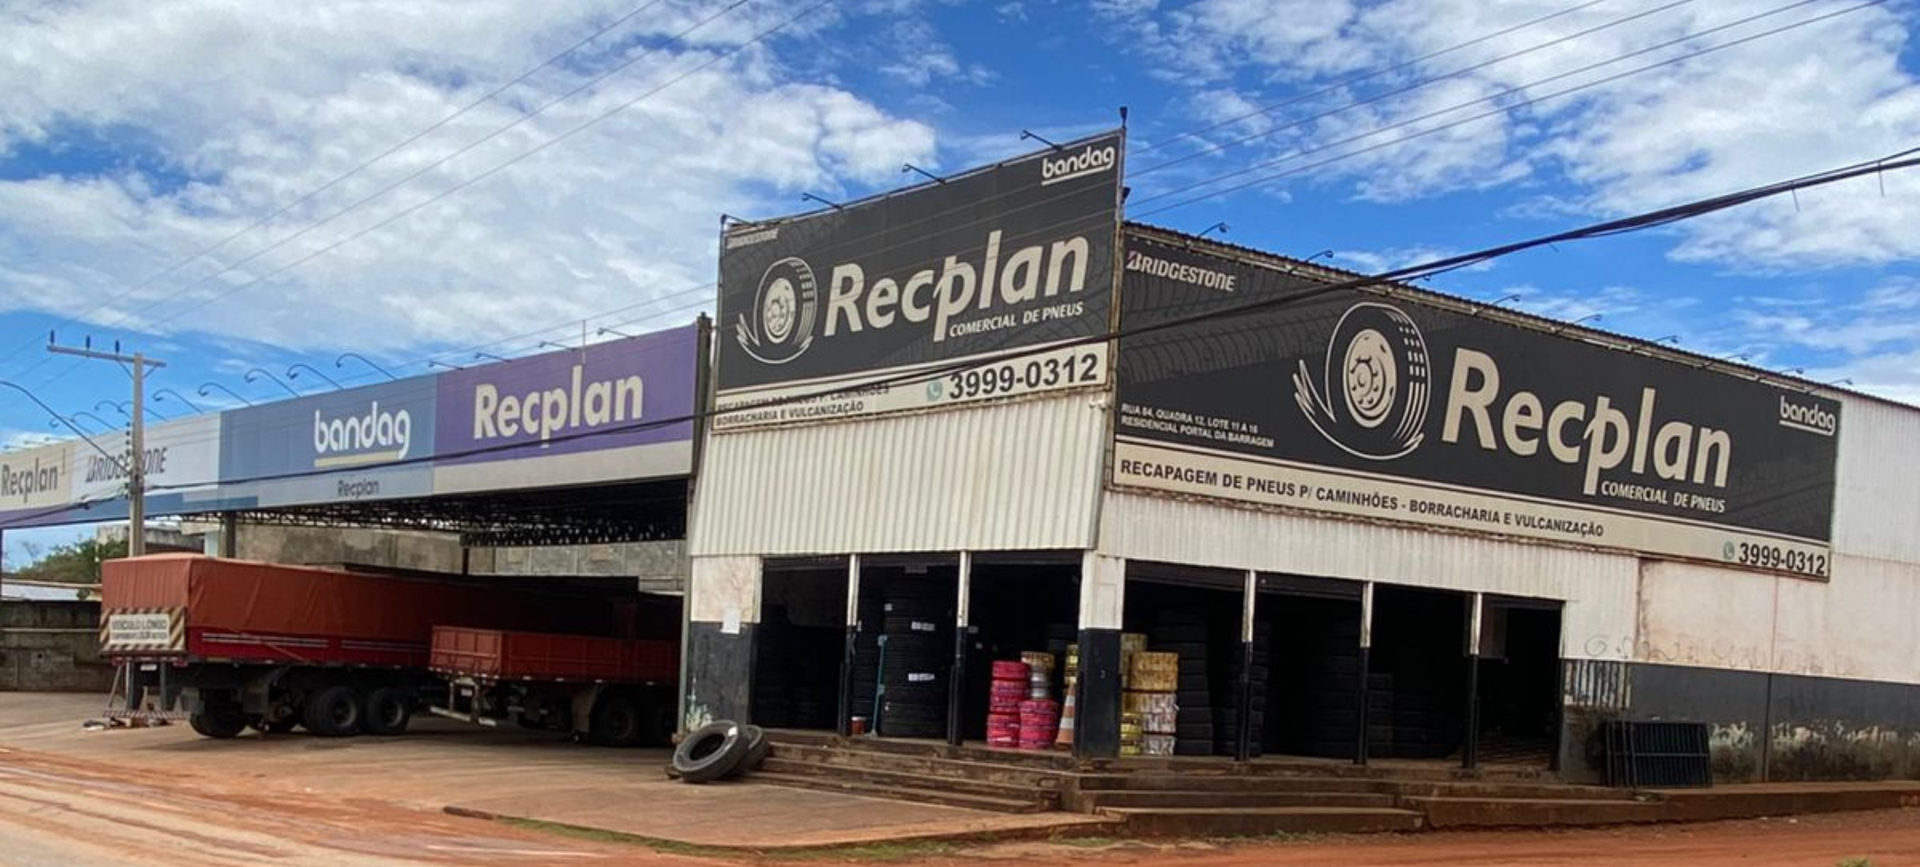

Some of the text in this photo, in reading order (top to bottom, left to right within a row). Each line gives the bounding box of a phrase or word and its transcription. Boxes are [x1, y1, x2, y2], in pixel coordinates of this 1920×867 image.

[1042, 146, 1115, 178] bandag
[823, 229, 1090, 343] Recplan
[1126, 250, 1237, 292] BRIDGESTONE
[949, 301, 1084, 338] COMERCIAL DE PNEUS
[948, 353, 1099, 399] 3999-0312
[473, 365, 644, 449] Recplan
[716, 400, 865, 427] BORRACHARIA E VULCANIZAÇÃO
[1121, 403, 1141, 416] RUA
[1156, 408, 1193, 424] QUADRA
[1207, 417, 1230, 430] LOTE
[1240, 422, 1248, 432] A
[1441, 347, 1731, 496] Recplan
[1779, 395, 1837, 437] bandag
[314, 401, 411, 460] bandag
[1121, 414, 1275, 448] RESIDENCIAL PORTAL DA BARRAGEM
[1, 456, 59, 503] Recplan
[338, 477, 380, 498] Recplan
[1120, 458, 1218, 486] RECAPAGEM
[1222, 473, 1243, 489] DE
[1246, 476, 1296, 497] PNEUS
[1299, 484, 1313, 500] P/
[1316, 487, 1399, 511] CAMINHÕES
[1409, 499, 1501, 525] BORRACHARIA
[1503, 511, 1512, 526] E
[1514, 513, 1605, 538] VULCANIZAÇÃO
[1600, 480, 1727, 514] COMERCIAL DE PNEUS
[1738, 542, 1826, 576] 3999-0312
